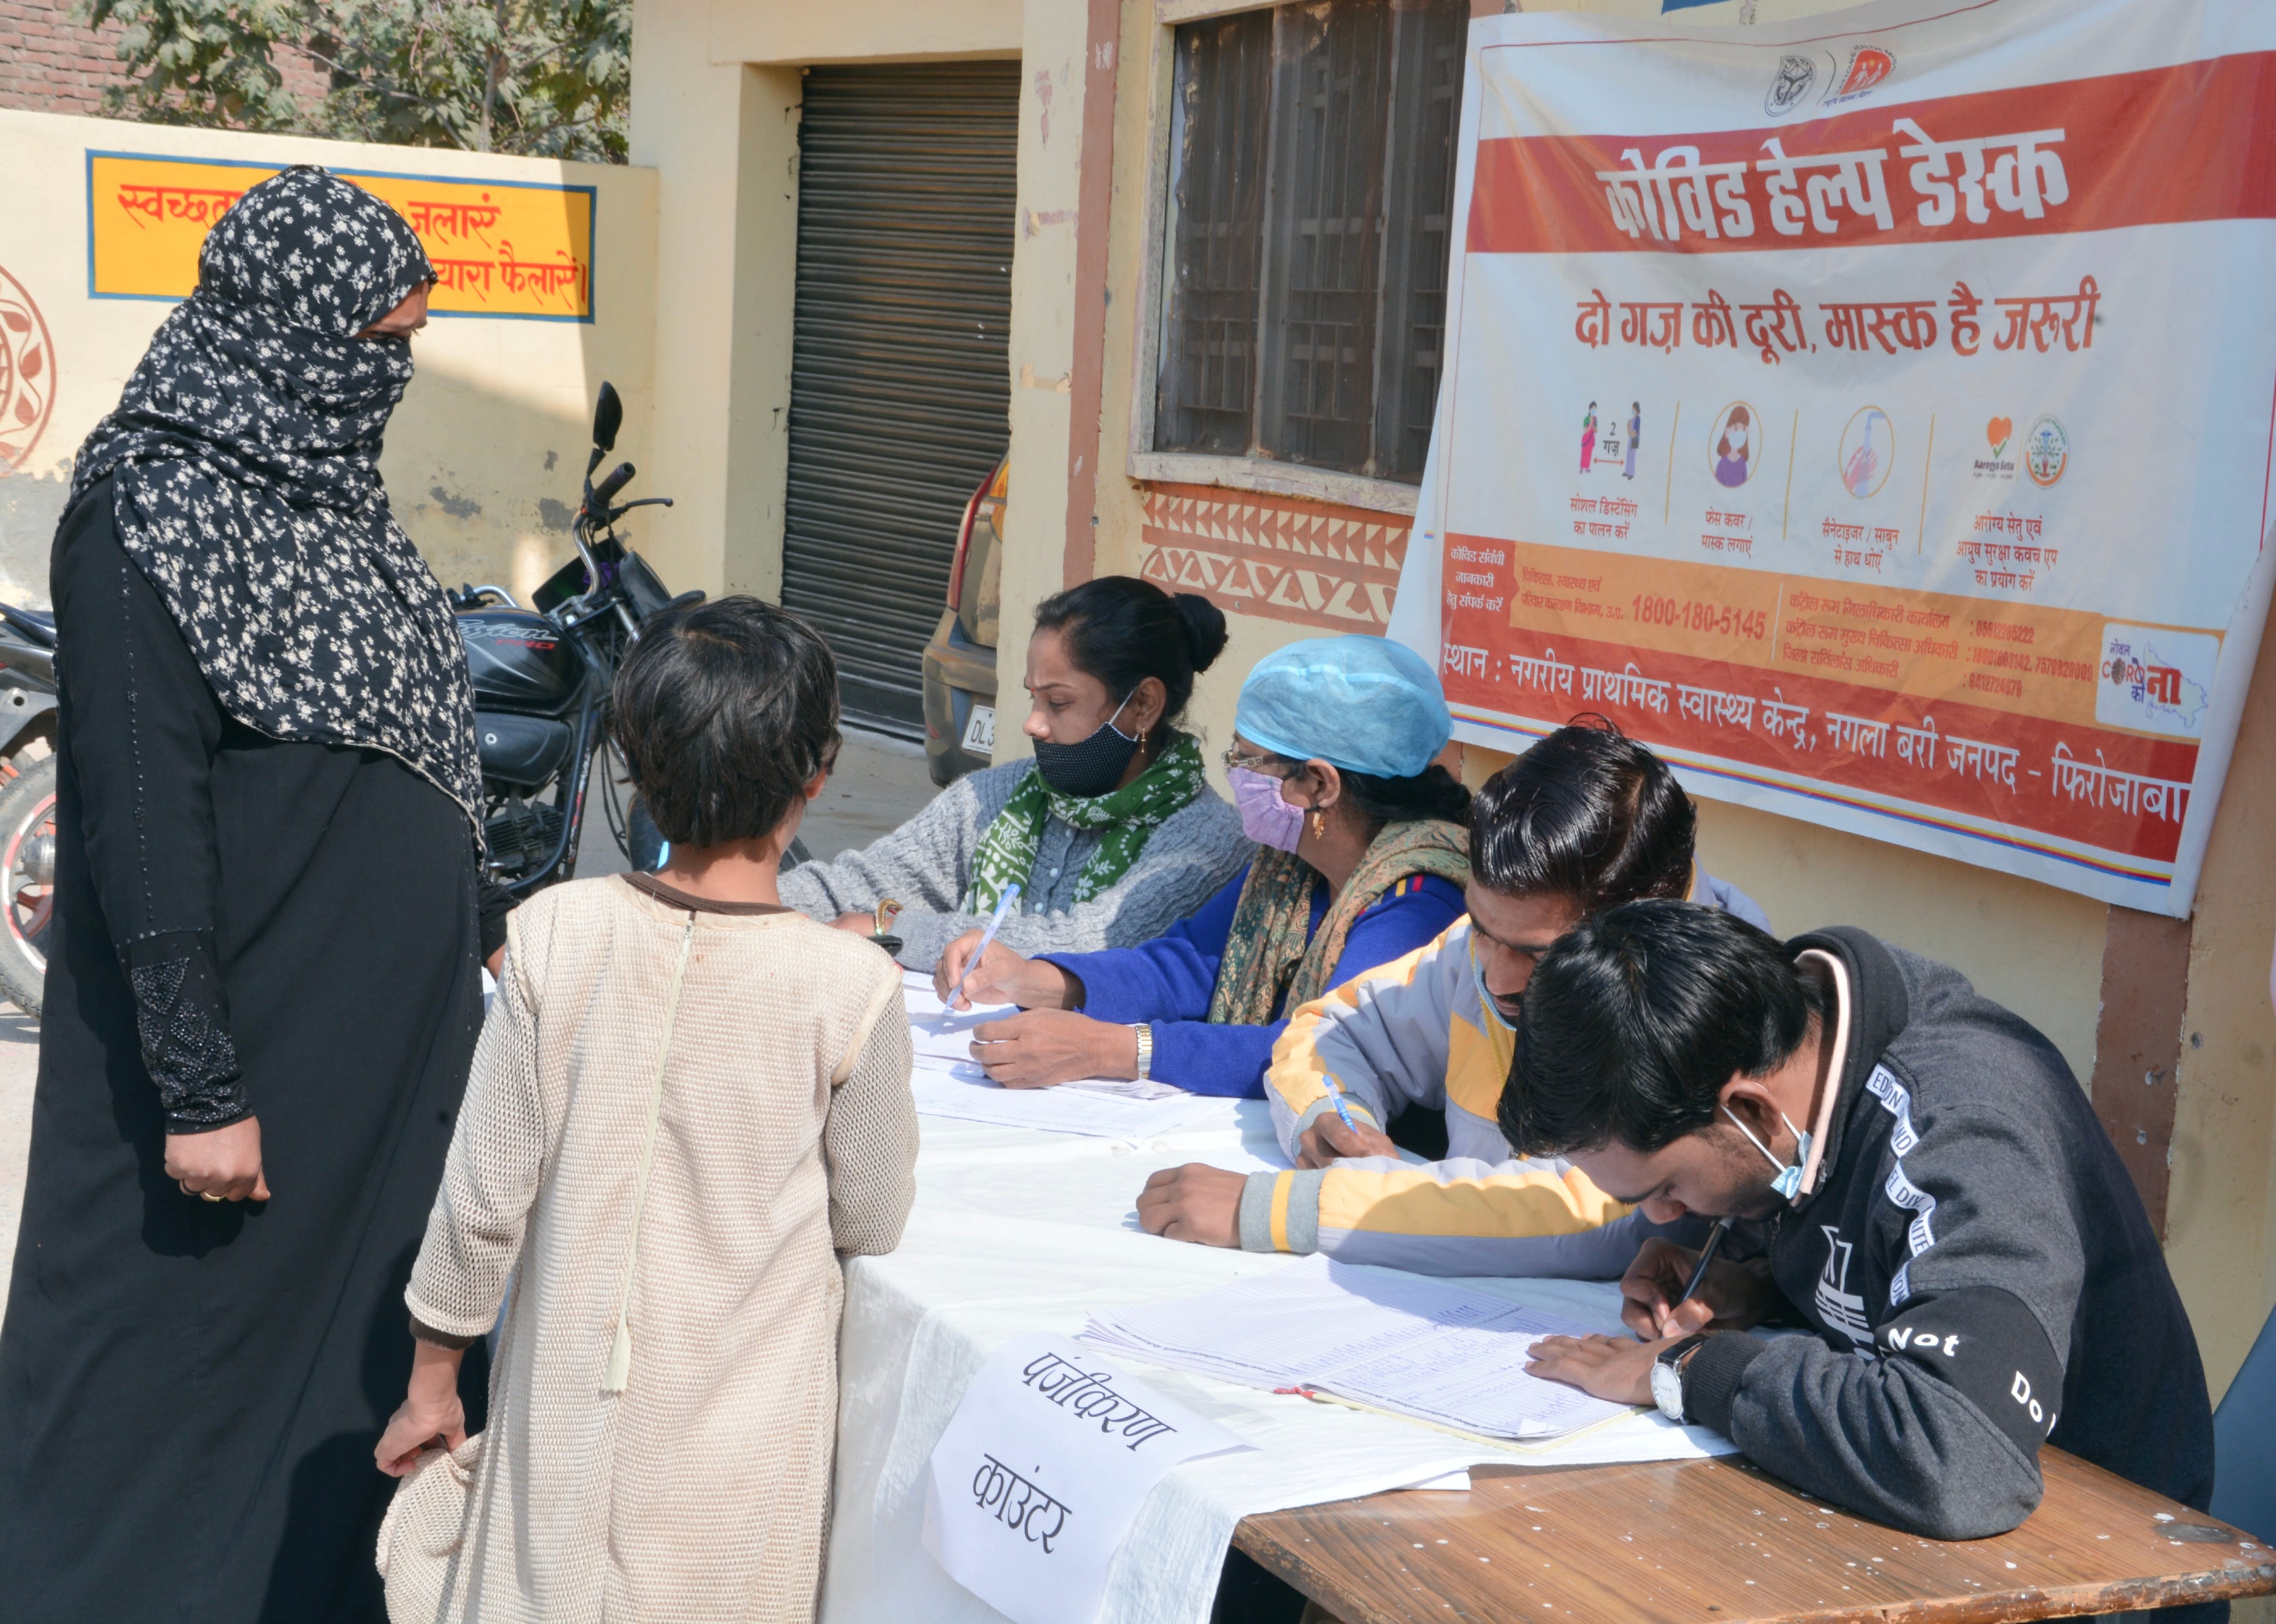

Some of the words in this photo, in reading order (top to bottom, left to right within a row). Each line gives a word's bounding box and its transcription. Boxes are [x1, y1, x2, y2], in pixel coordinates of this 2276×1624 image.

[1595, 145, 1755, 241] कोविड
[1756, 137, 1894, 235] हेल्प
[1892, 118, 2069, 226] डेस्क
[118, 184, 247, 230] स्वच्छत
[430, 258, 496, 303] यारा
[1575, 289, 1611, 349] दो
[1620, 302, 1683, 354] गज़
[1692, 289, 1738, 348] की
[1739, 288, 1817, 366] दूरी,
[1819, 301, 1937, 355] मास्क
[1947, 280, 1983, 356] है
[1993, 275, 2101, 352] जरूरी
[1609, 422, 1616, 436] 2
[1974, 460, 1999, 472] Aarogya
[2000, 460, 2014, 471] Setu
[1570, 493, 1597, 514] सोशल
[1574, 521, 1587, 535] का
[1588, 522, 1613, 538] पालन
[1615, 521, 1630, 540] करें
[1705, 507, 1722, 527] फेस
[1724, 513, 1745, 530] कवर
[1974, 510, 2004, 533] आरोग्य
[2007, 511, 2022, 541] सेतु
[2025, 515, 2043, 541] एवं
[1702, 534, 1725, 551] मास्क
[1727, 535, 1753, 558] लगाएं
[1822, 517, 1864, 543] सैनेटाइजर
[1874, 527, 1899, 551] साबुन
[1451, 545, 1477, 563] कोविड
[1478, 548, 1505, 566] संबंधी
[1834, 545, 1843, 566] से
[1845, 551, 1862, 568] हाथ
[1864, 548, 1884, 573] धोएं
[1956, 540, 1981, 564] आयुष
[1984, 543, 2011, 566] सुरक्षा
[2013, 545, 2041, 564] कवच
[2044, 548, 2058, 570] एप
[1456, 571, 1494, 587] जानकारी
[1556, 574, 1587, 590] स्वास्थ्य
[1588, 576, 1603, 593] एवं
[1974, 569, 1988, 586] का
[1990, 567, 2016, 589] प्रयोग
[2019, 569, 2035, 591] करें
[1446, 590, 1458, 610] हेतु
[1459, 591, 1485, 609] संपर्क
[1486, 597, 1503, 612] करें
[1521, 590, 1544, 609] परिवार
[1544, 597, 1573, 613] कल्याण
[1821, 598, 1841, 614] रूम
[1843, 597, 1905, 623] जिलाधिकारी
[1907, 608, 1950, 629] कार्यालय
[1633, 594, 1767, 640] 1800-180-5145
[495, 638, 555, 650] PRO
[1818, 625, 1839, 640] रूम
[1840, 628, 1866, 648] मुख्य
[1868, 628, 1912, 652] चिकित्सा
[1914, 637, 1959, 660] अधिकारी
[2110, 638, 2131, 656] नोवल
[1782, 642, 1808, 663] जिला
[1855, 656, 1899, 678] अधिकारी
[970, 720, 986, 744] DL
[1444, 642, 1489, 680] स्थान
[1510, 648, 1574, 696] नगरीय
[1580, 662, 1670, 714] प्राथमिक
[1676, 684, 1756, 731] स्वास्थ्य
[1826, 711, 1890, 759] नगला
[1897, 715, 1939, 770] बरी
[1945, 734, 2020, 795] जनपद
[2051, 741, 2192, 824] फिरोजाबा
[1888, 1327, 1960, 1357] Not
[973, 1453, 1073, 1555] काउंटर
